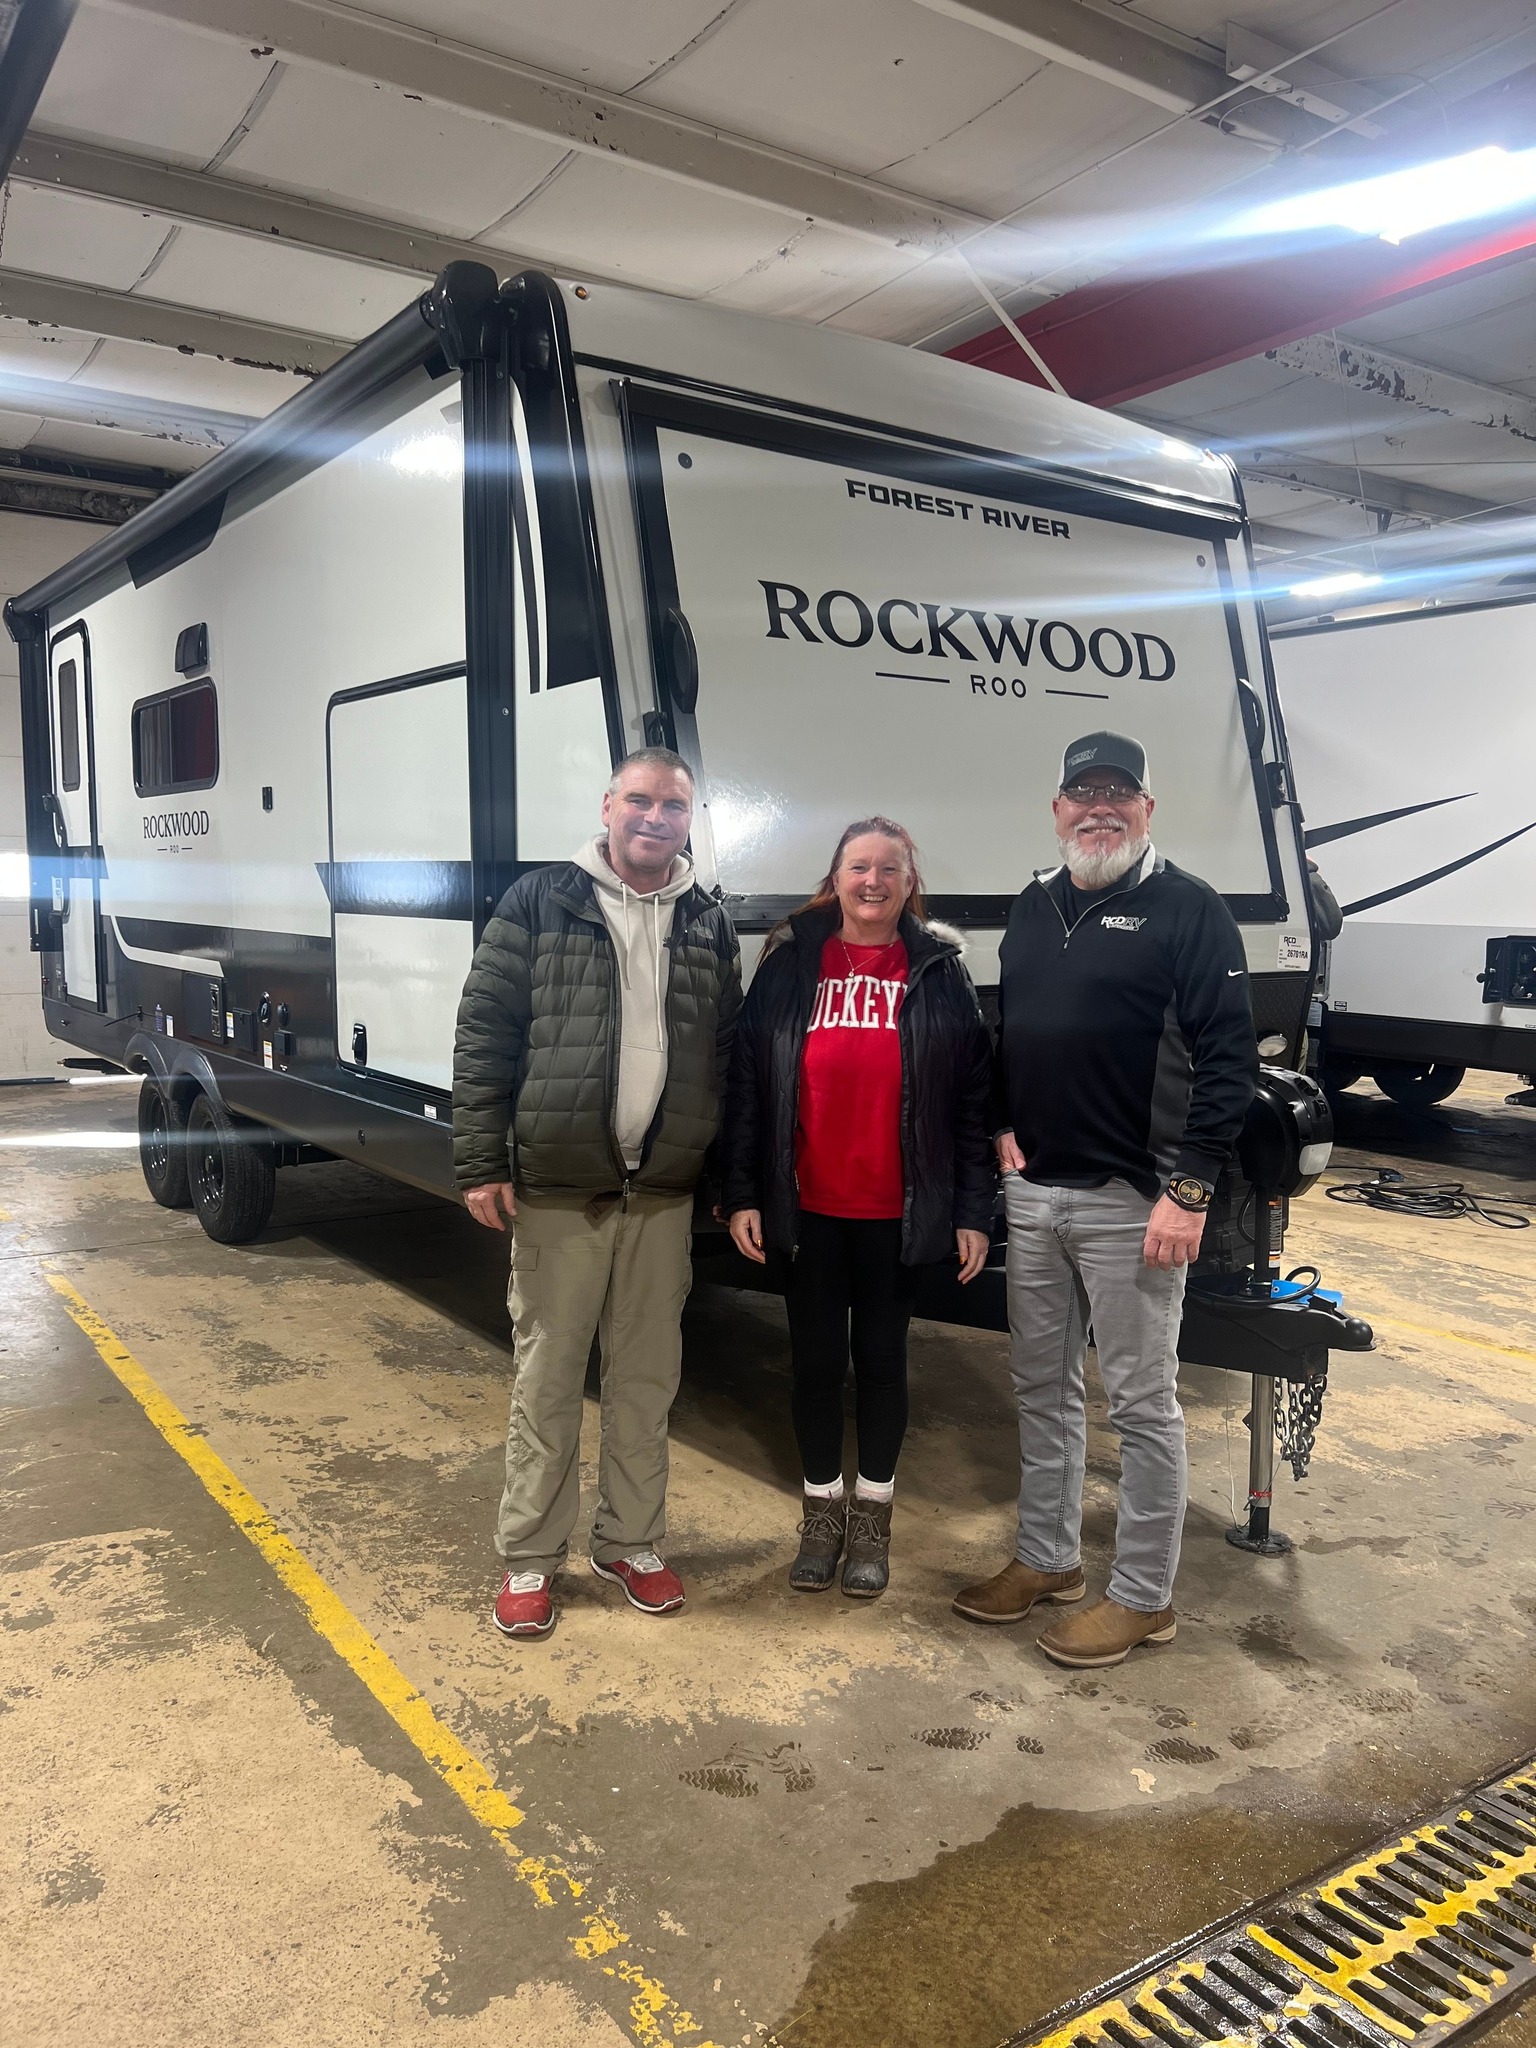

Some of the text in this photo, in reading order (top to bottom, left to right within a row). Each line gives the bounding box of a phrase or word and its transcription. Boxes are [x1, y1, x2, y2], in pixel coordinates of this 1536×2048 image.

[845, 479, 1071, 539] FOREST RIVER
[757, 579, 1176, 682] ROCKWOOD
[970, 674, 1027, 699] ROO
[143, 810, 210, 839] ROCKWOOD
[806, 974, 909, 1034] UCKEY
